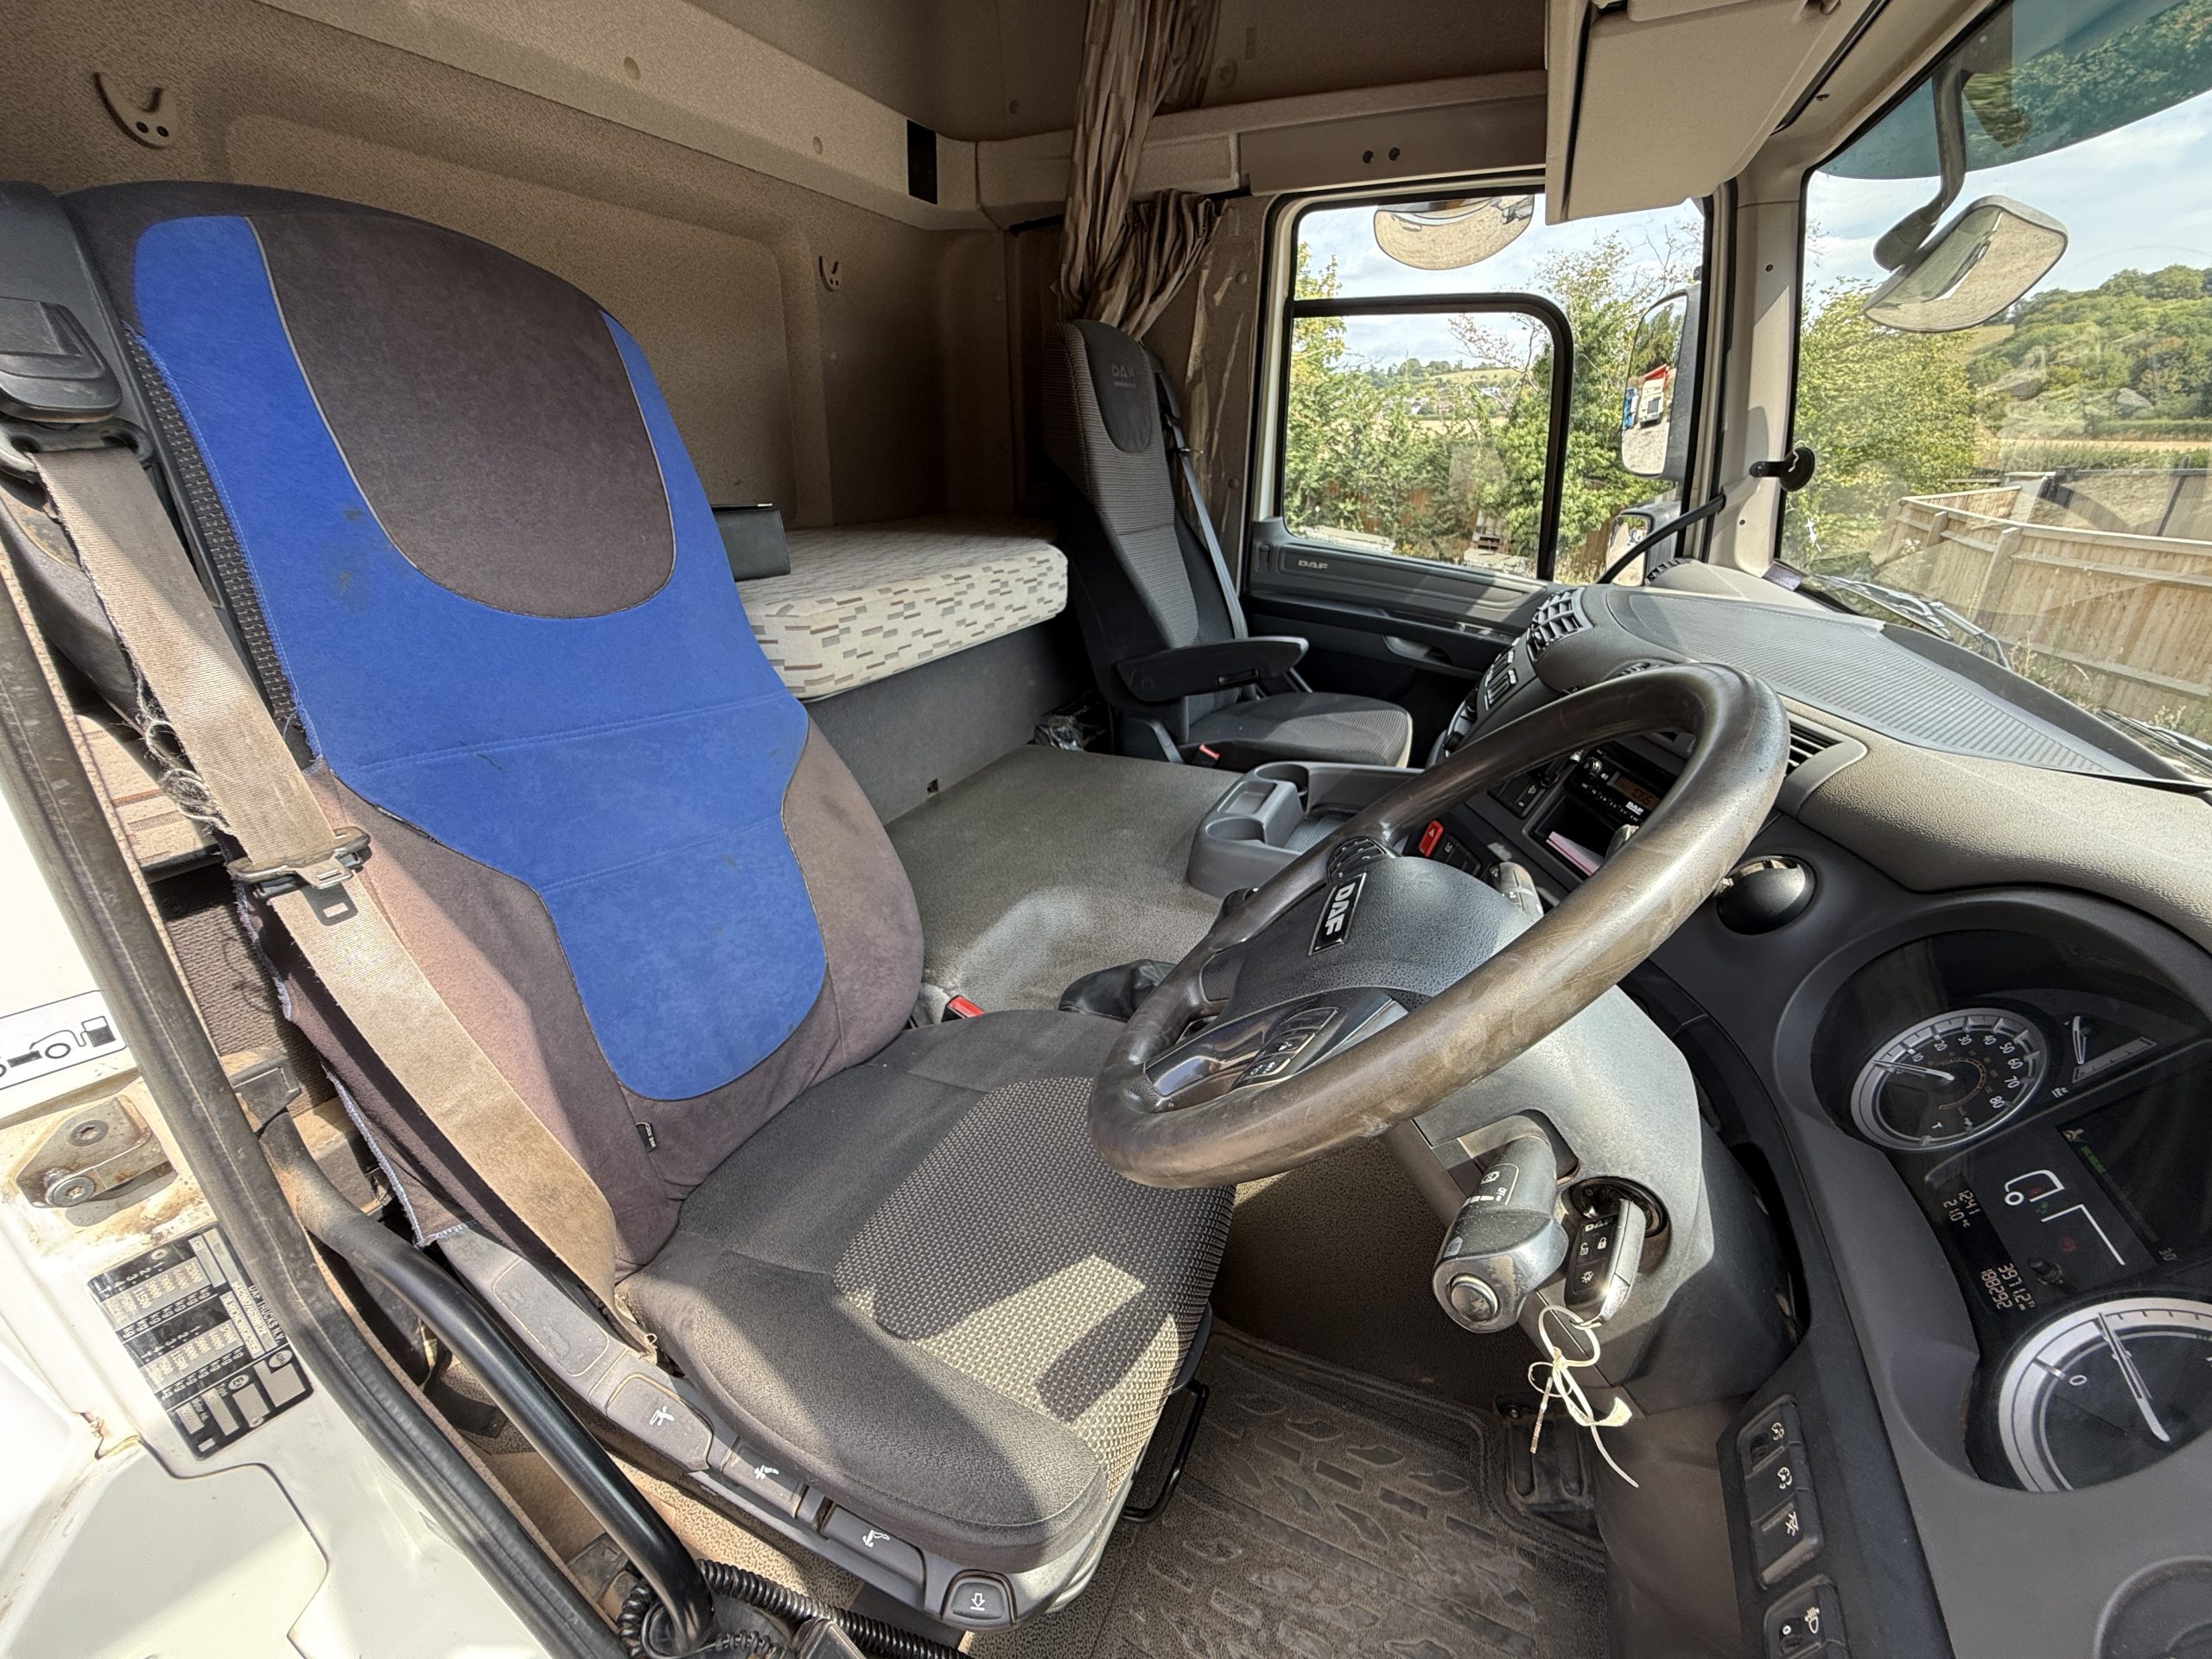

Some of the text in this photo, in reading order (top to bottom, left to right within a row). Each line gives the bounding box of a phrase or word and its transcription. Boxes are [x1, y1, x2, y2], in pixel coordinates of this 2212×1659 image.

[1298, 559, 1328, 570] DAF
[1625, 800, 1645, 815] DAF
[1325, 882, 1357, 936] DAF
[1934, 1039, 1948, 1052] 20
[1958, 1033, 1972, 1046] 30
[1982, 1034, 1996, 1046] 40
[1999, 1041, 2014, 1055] 50
[1911, 1052, 1923, 1063] 10
[2006, 1057, 2023, 1070] 60
[2003, 1075, 2020, 1090] 70
[1988, 1095, 2005, 1109] 80
[1958, 1190, 1980, 1215] 12:41
[1586, 1219, 1614, 1231] DAF
[2158, 1247, 2177, 1262] 30
[1980, 1268, 2012, 1310] 188292
[255, 1300, 278, 1329] TRUCKS
[2069, 1375, 2088, 1386] 0
